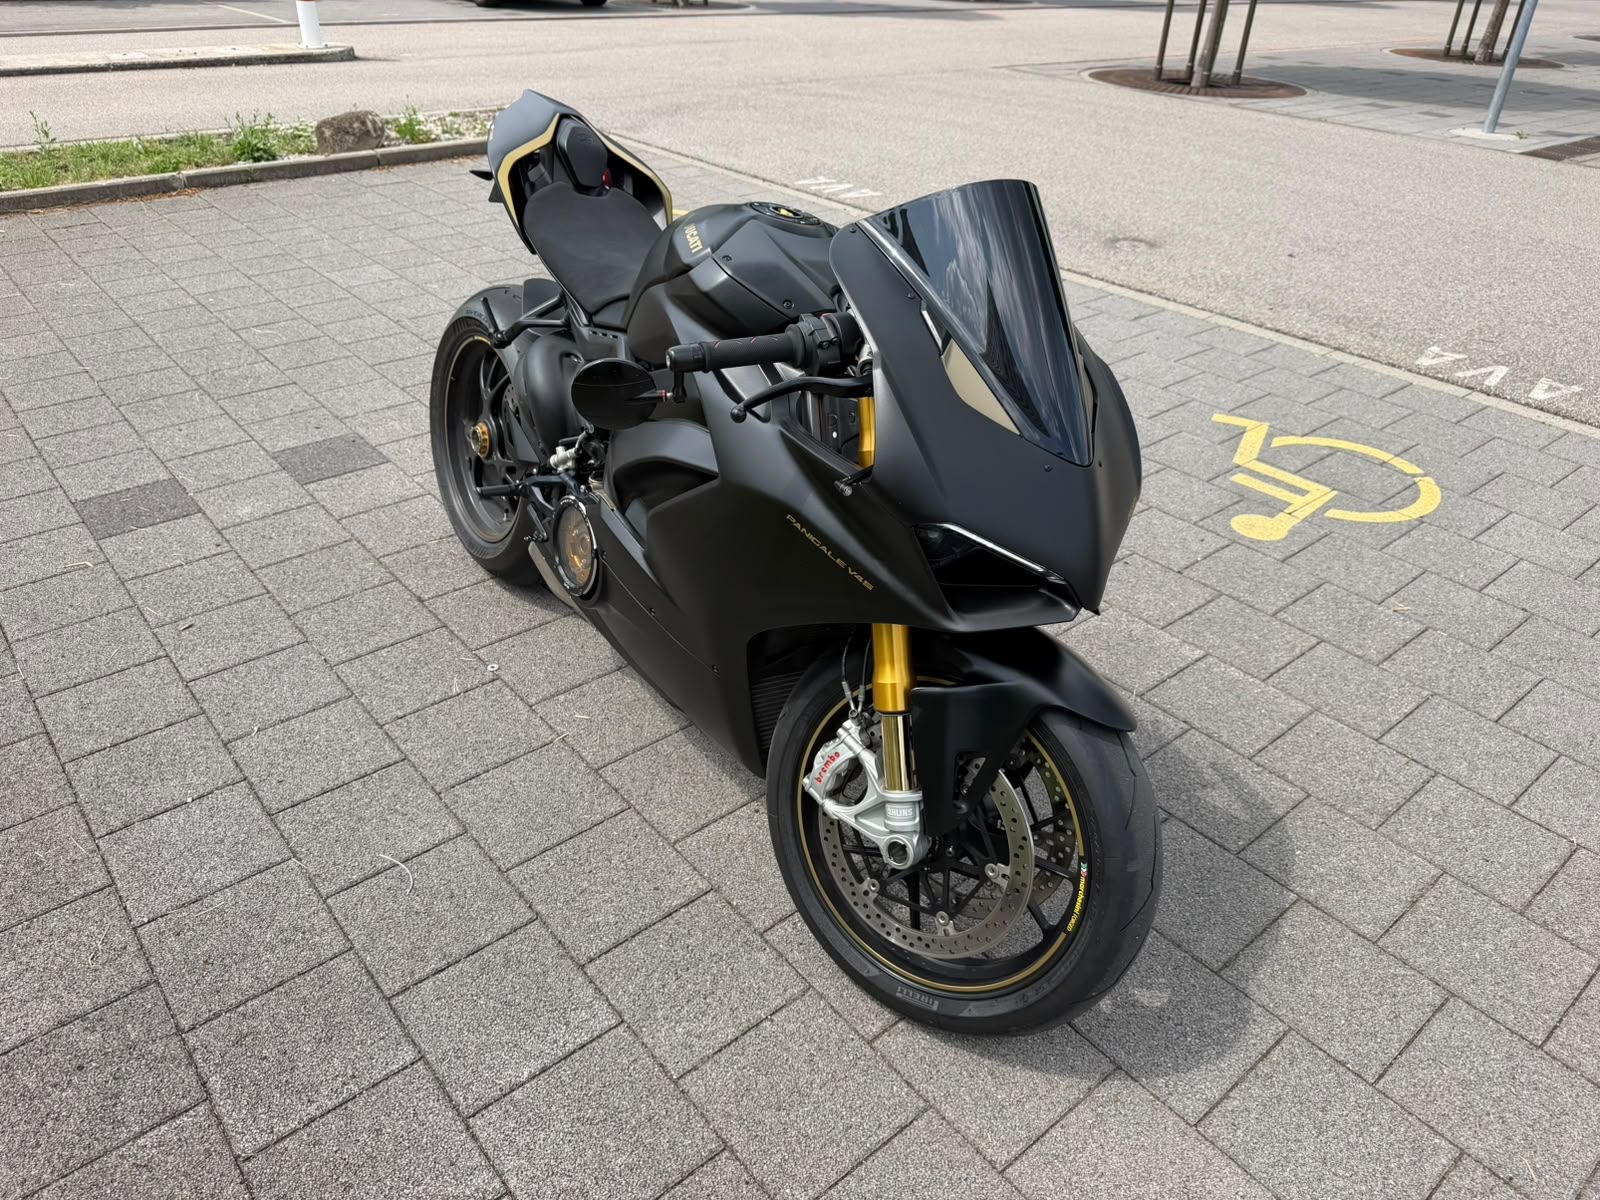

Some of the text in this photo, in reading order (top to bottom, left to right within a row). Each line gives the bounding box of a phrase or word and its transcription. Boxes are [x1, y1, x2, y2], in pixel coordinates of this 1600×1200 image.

[786, 514, 875, 591] PANIGALE V4S
[815, 751, 841, 784] brembo
